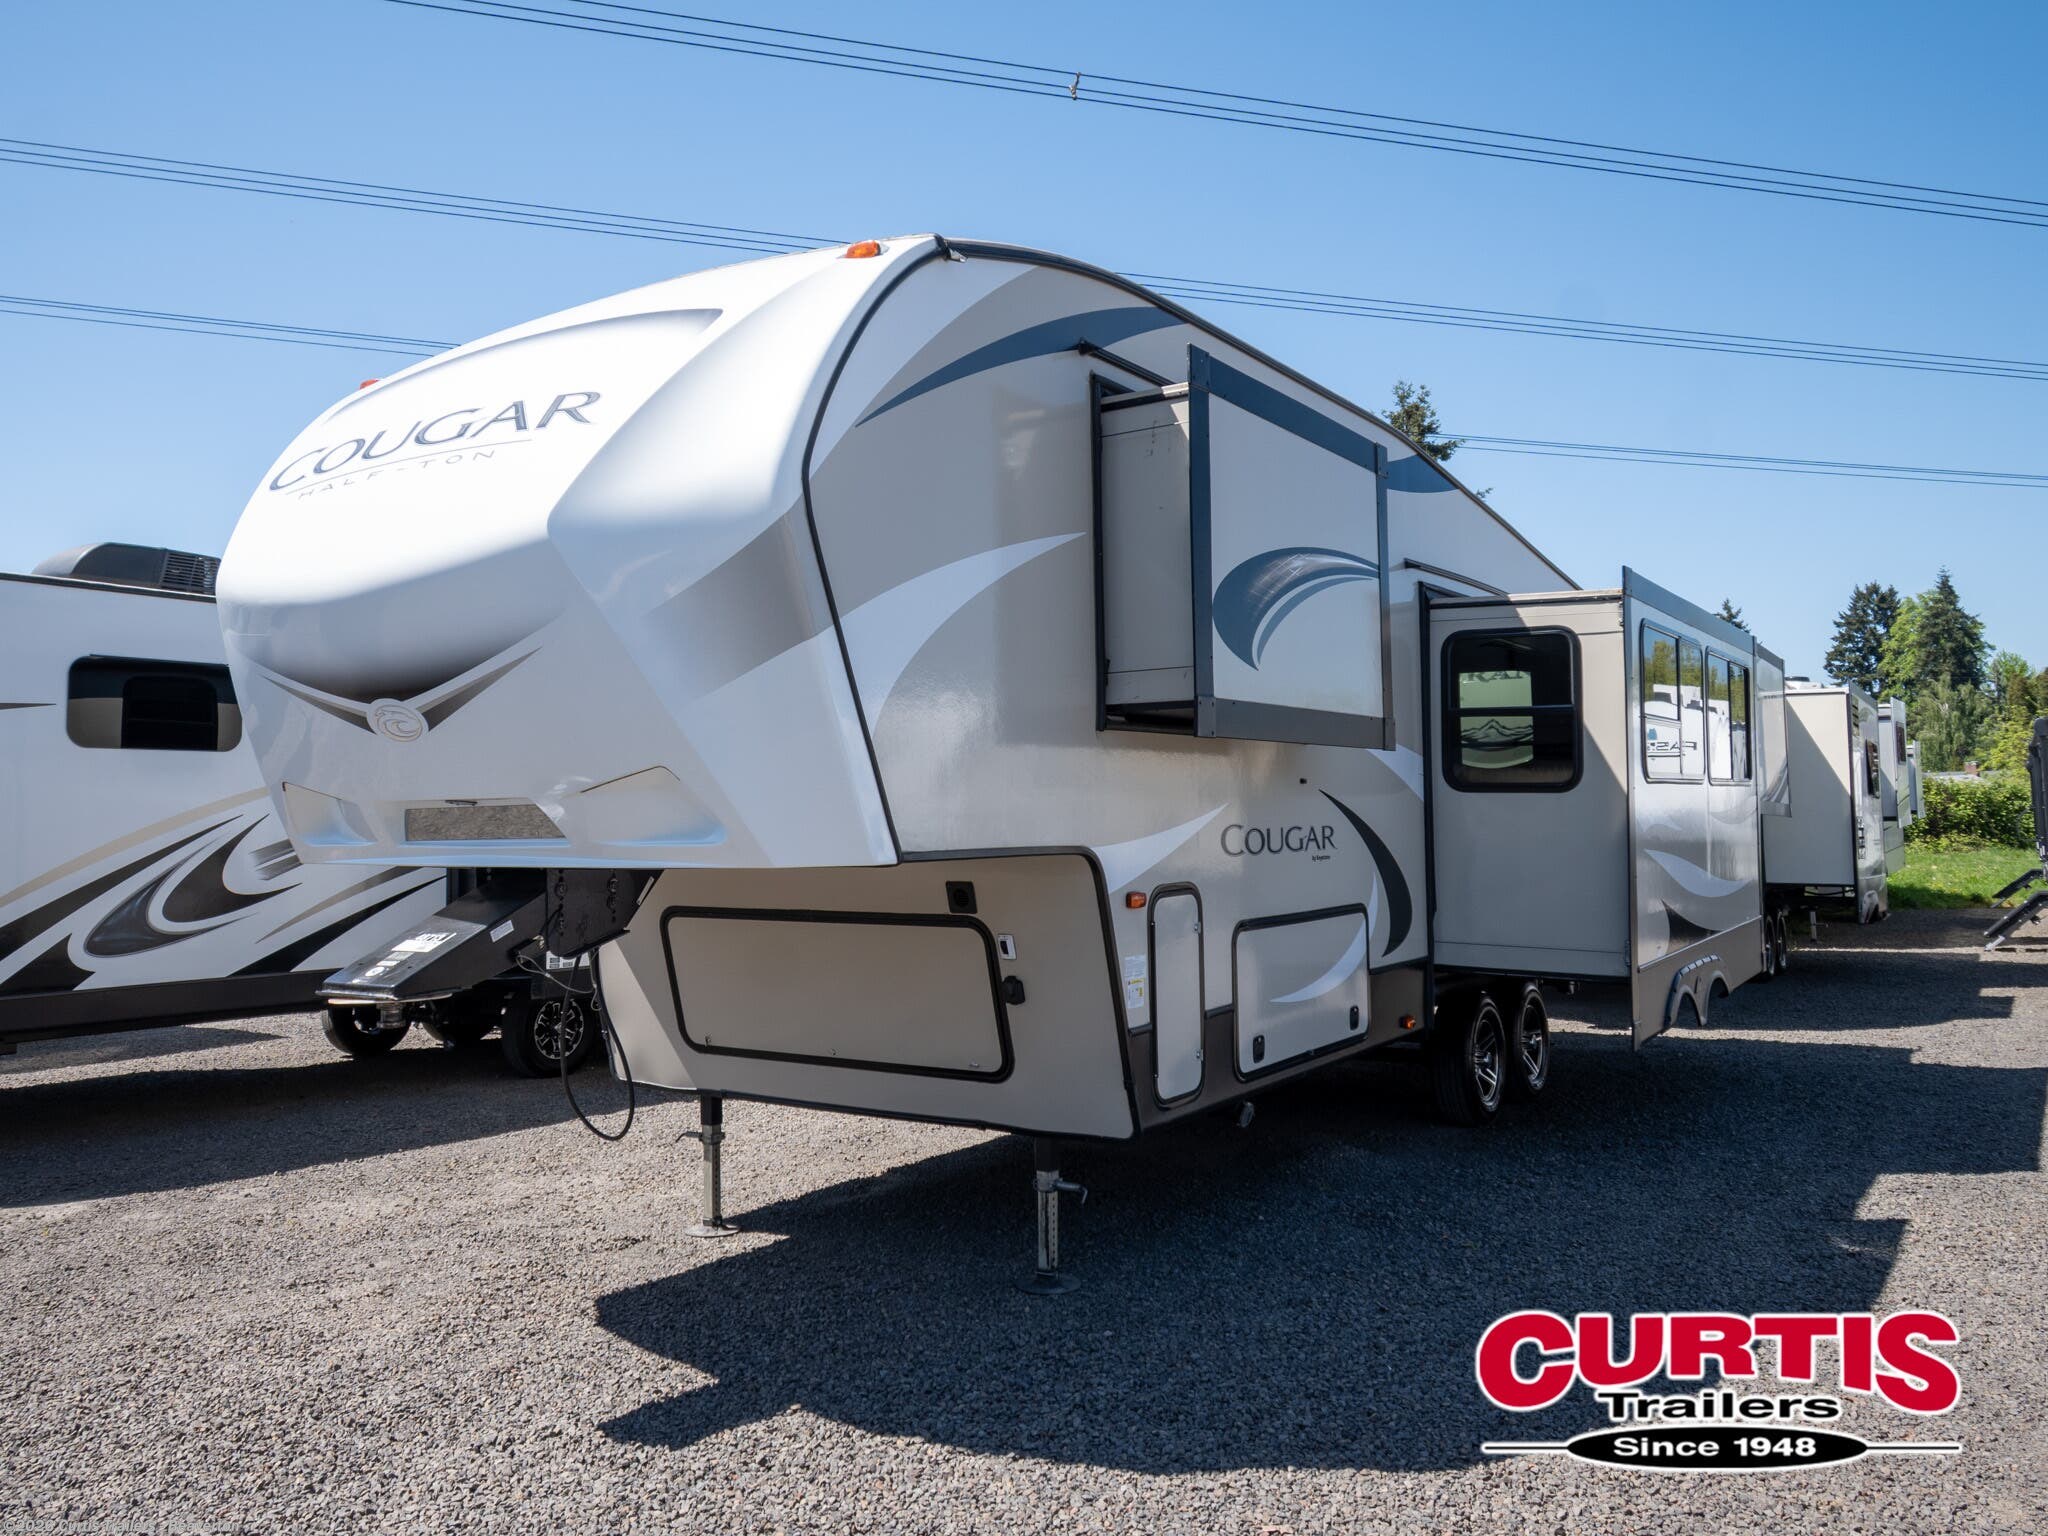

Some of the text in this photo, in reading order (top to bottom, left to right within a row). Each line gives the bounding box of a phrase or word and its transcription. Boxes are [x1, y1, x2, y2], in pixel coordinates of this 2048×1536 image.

[269, 391, 601, 490] COUGAR
[297, 449, 495, 500] HALF-TON
[1220, 824, 1338, 857] COUGAR
